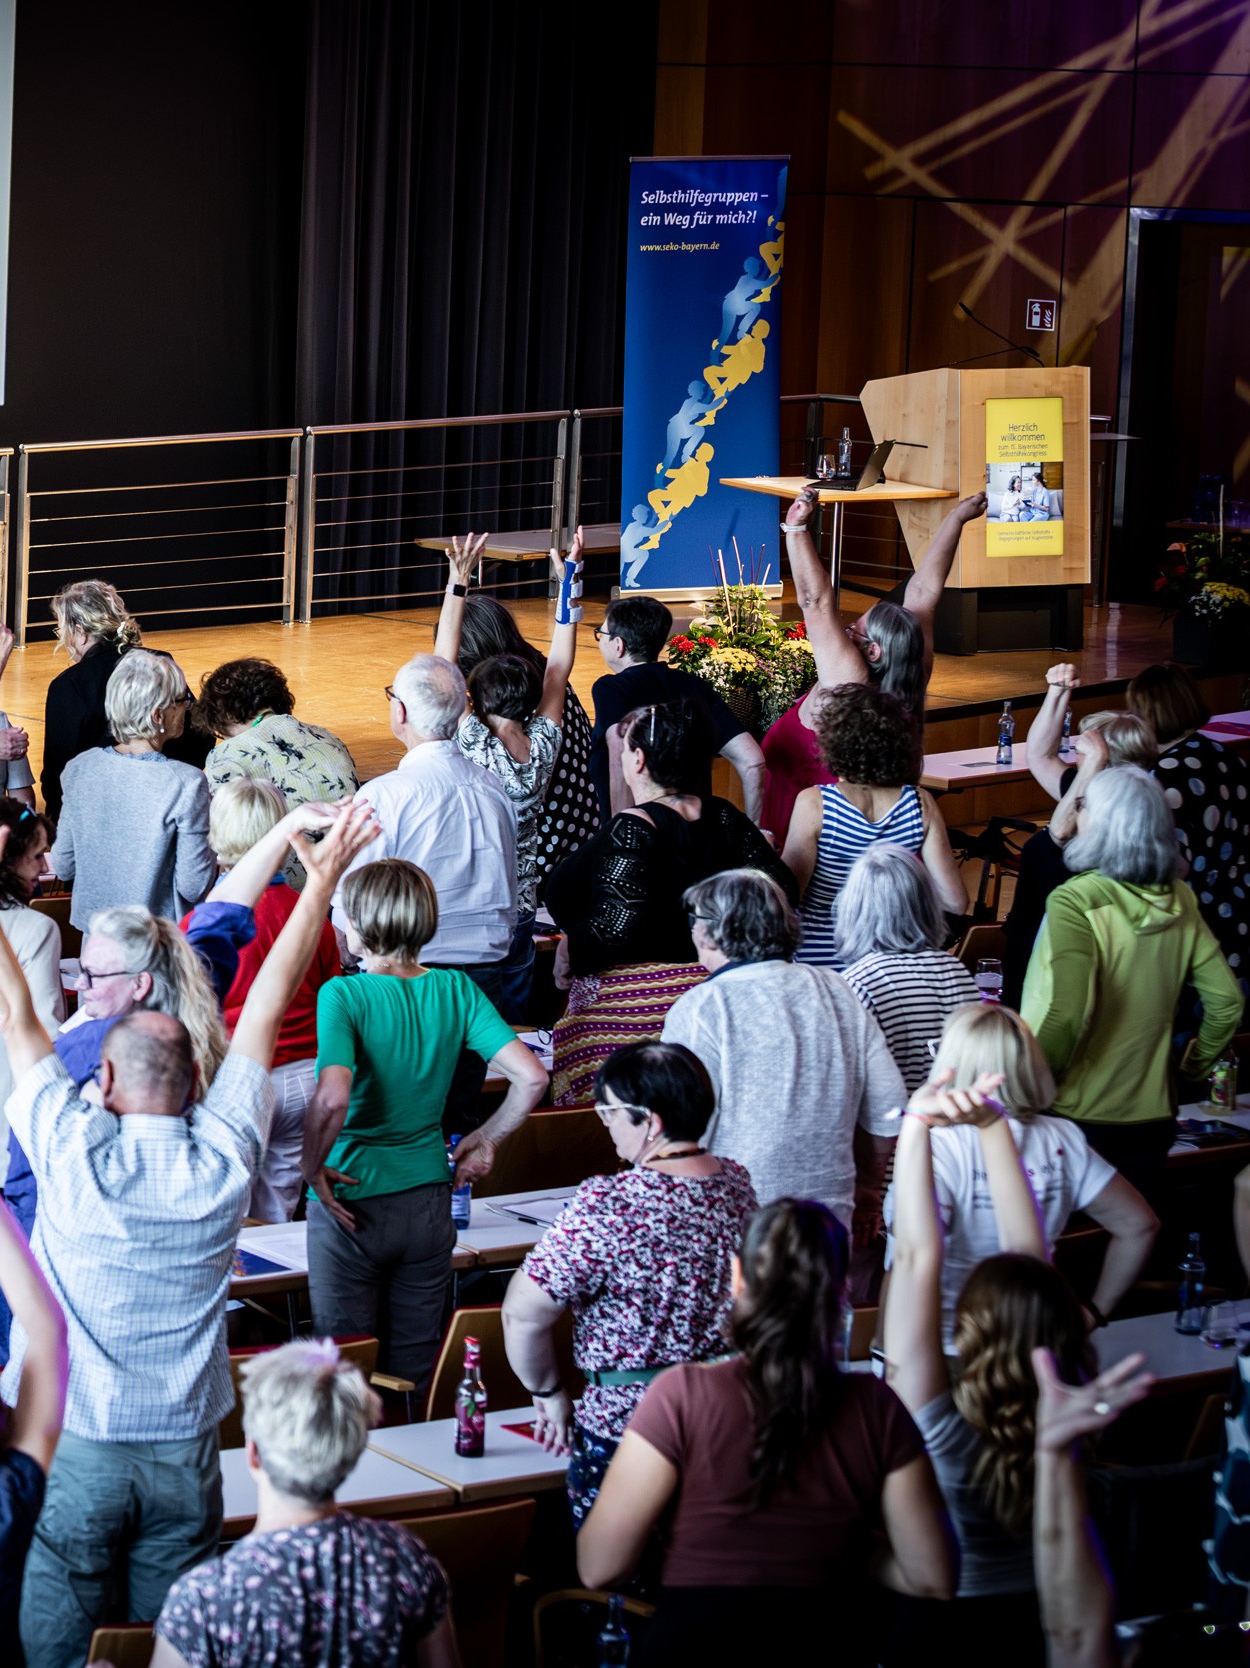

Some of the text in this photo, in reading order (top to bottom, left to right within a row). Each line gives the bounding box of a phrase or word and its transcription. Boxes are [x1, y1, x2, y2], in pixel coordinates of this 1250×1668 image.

[640, 189, 758, 206] Selbsthilfegruppen
[640, 210, 758, 229] ein Weg für mich?!
[639, 241, 720, 252] www.seko-bayern.de
[1008, 423, 1038, 432] Herzlich
[1000, 433, 1046, 442] willkommen
[1017, 443, 1048, 451] Bayerischen
